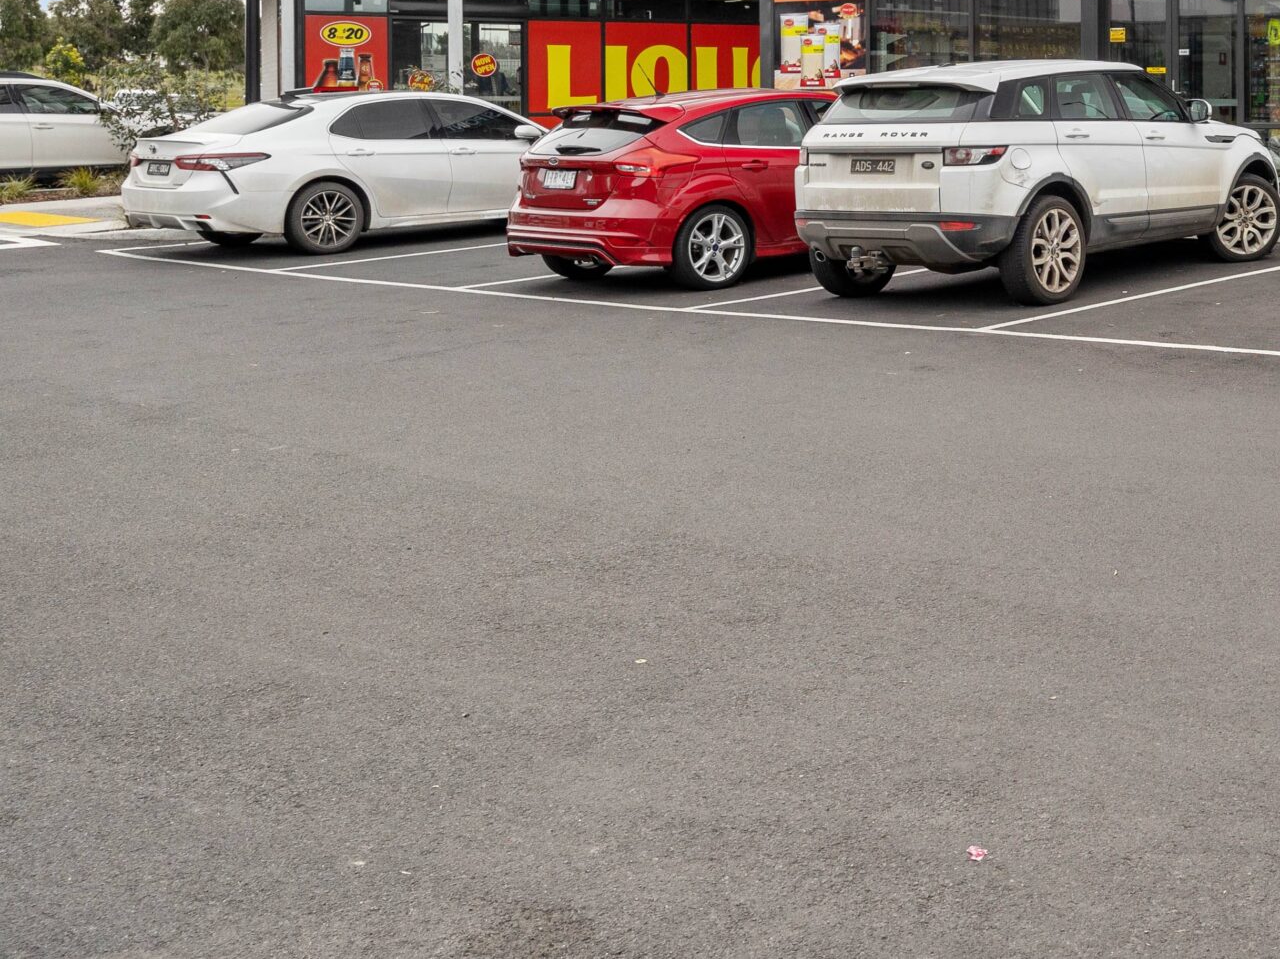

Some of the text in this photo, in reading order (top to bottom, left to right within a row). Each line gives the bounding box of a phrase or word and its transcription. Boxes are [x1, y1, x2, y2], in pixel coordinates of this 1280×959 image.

[327, 27, 338, 39] 8
[475, 56, 491, 66] NOW
[477, 63, 495, 74] OPEN
